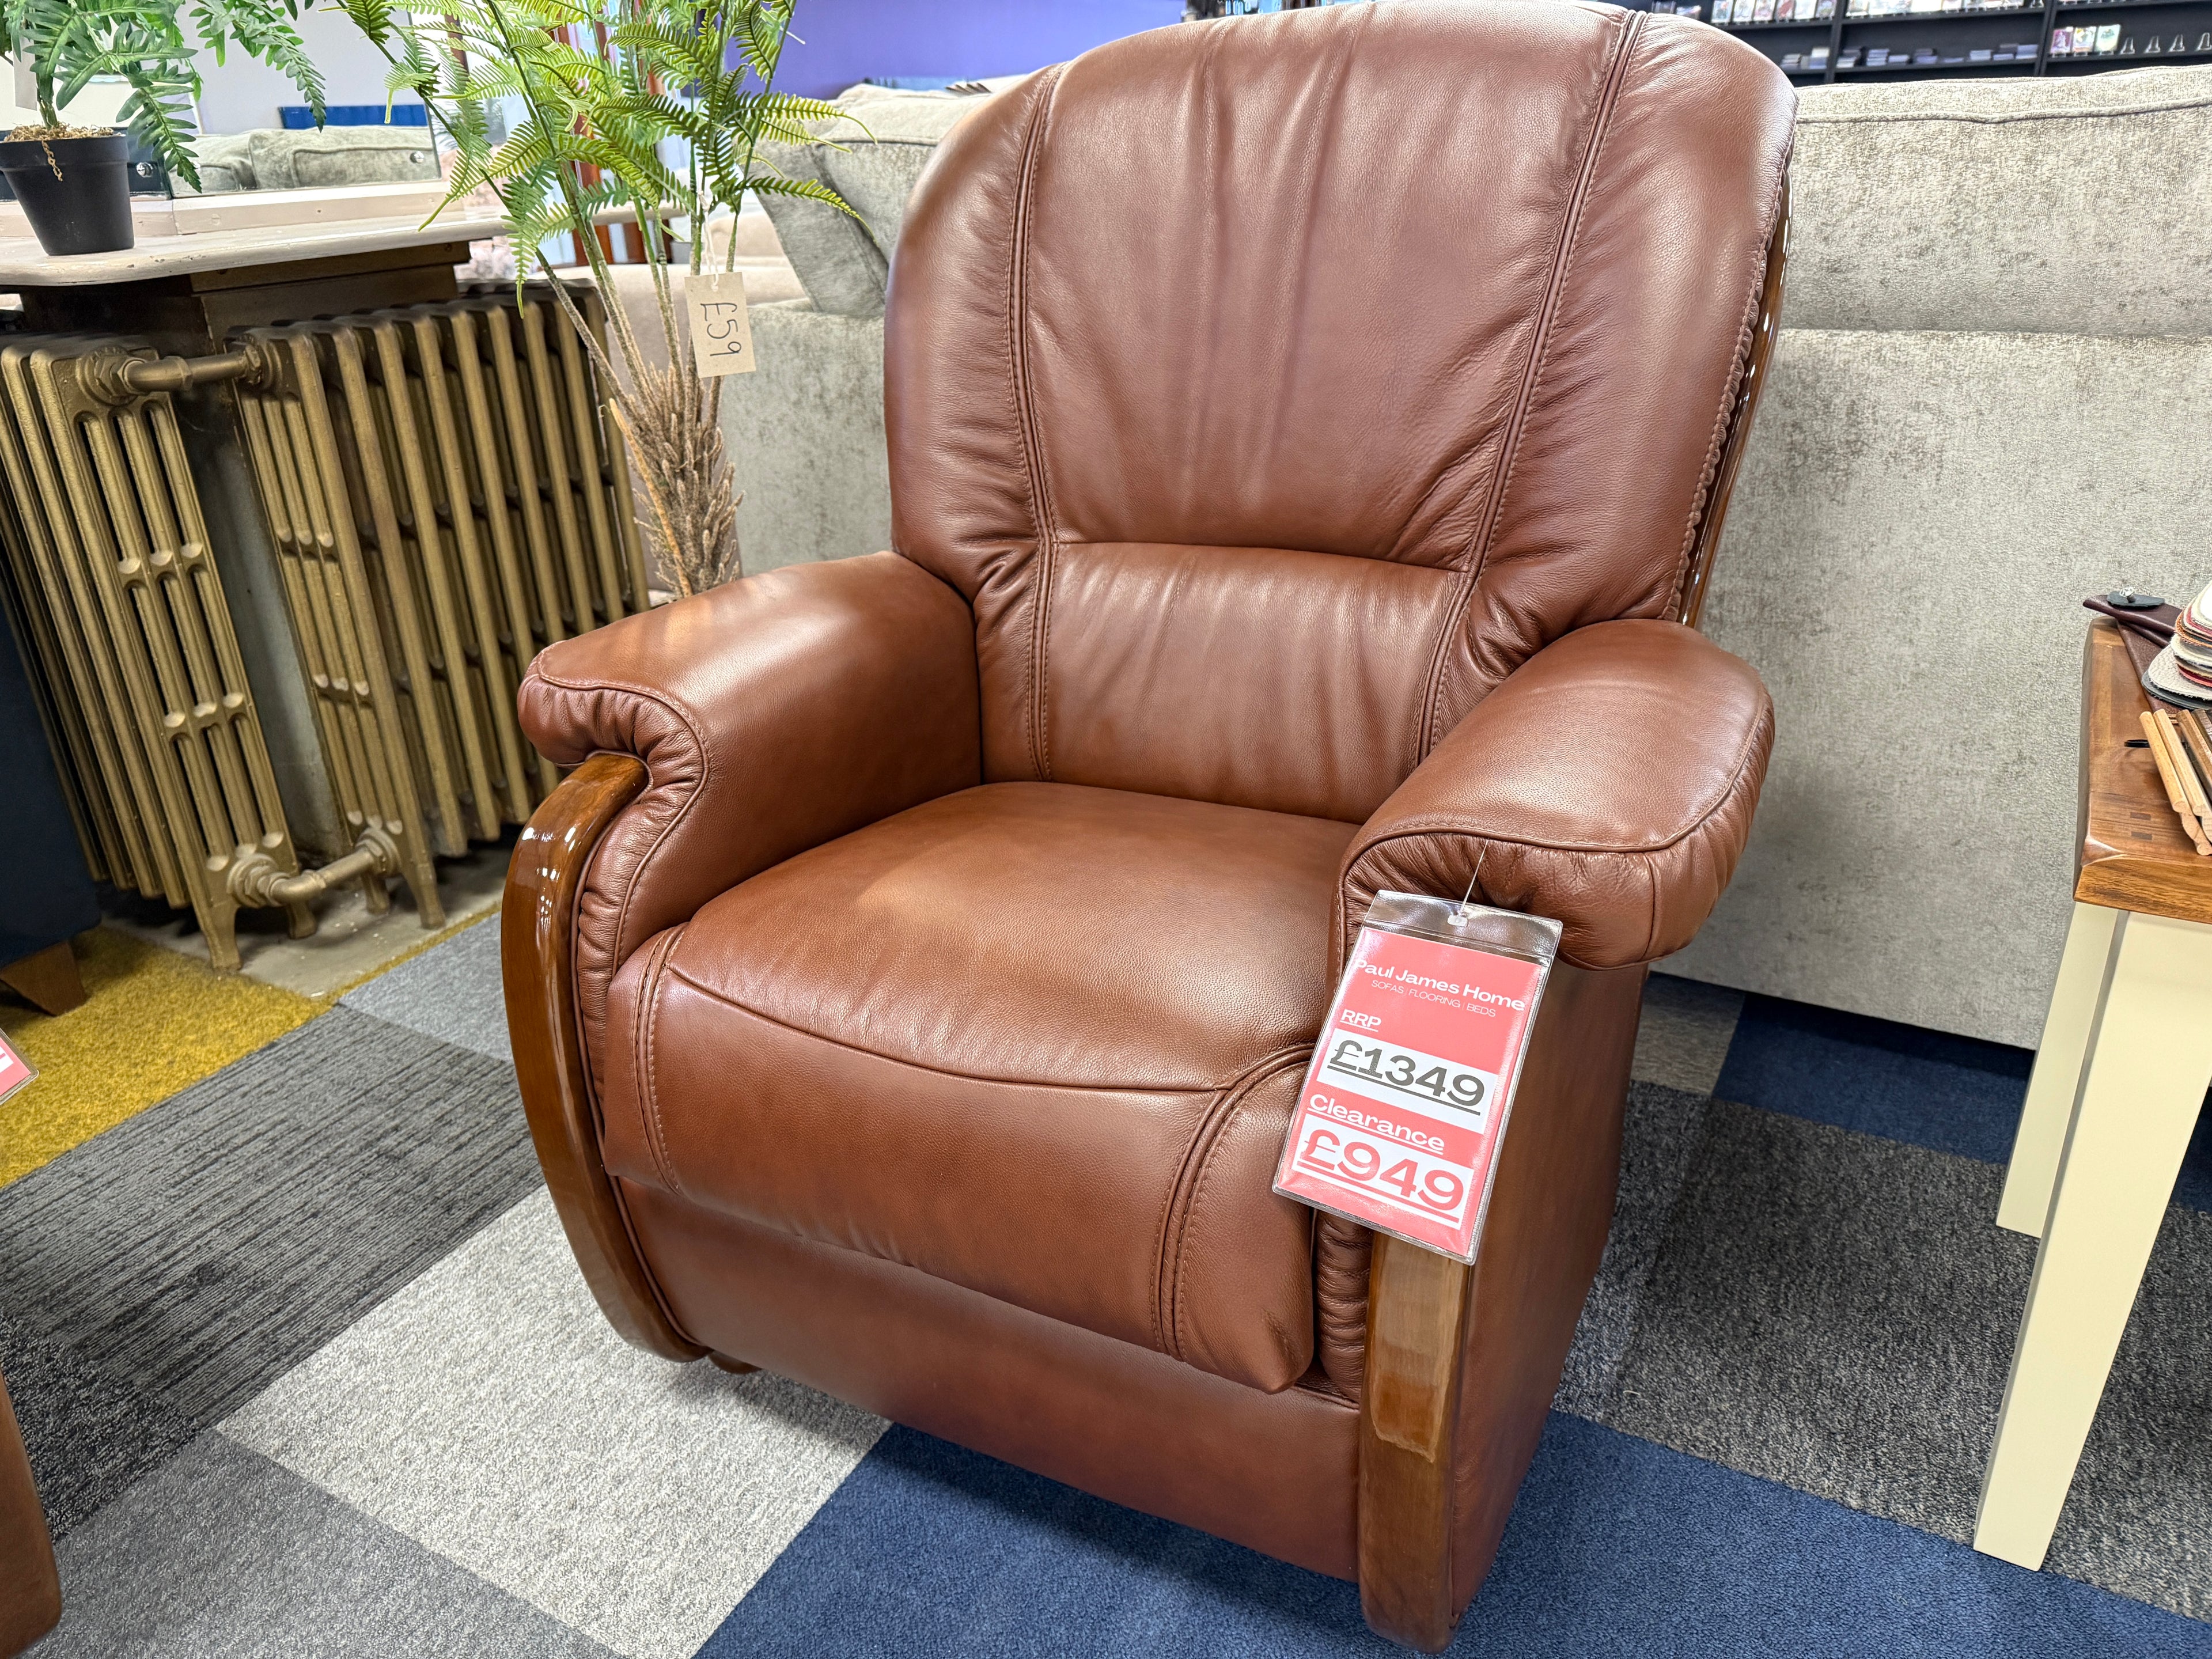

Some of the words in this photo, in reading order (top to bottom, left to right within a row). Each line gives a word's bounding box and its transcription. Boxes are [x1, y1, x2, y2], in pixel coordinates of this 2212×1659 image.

[700, 302, 742, 357] £59
[1354, 959, 1395, 978] Paul
[1395, 970, 1459, 994] James
[1463, 984, 1526, 1011] Home
[1372, 980, 1404, 994] SOFAS
[1408, 988, 1461, 1008] FLOORING
[1466, 1003, 1496, 1017] BEDS
[1341, 1009, 1381, 1028] RRP
[1330, 1040, 1484, 1106] £1349
[1309, 1094, 1445, 1150] Clearance
[1300, 1129, 1464, 1211] £949
